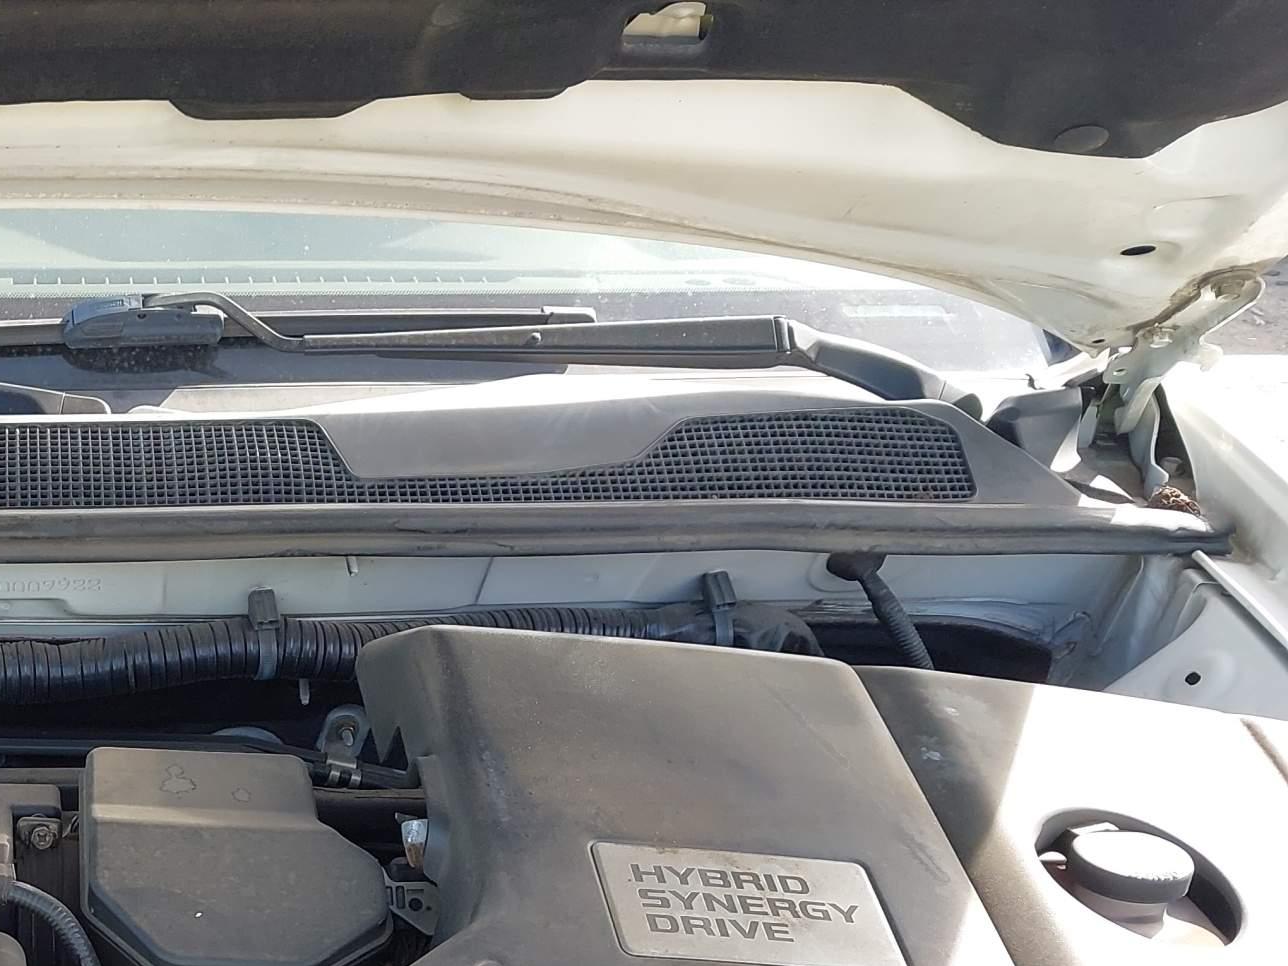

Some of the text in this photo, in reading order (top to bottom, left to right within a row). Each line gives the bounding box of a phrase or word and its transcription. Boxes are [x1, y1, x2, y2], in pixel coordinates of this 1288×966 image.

[630, 863, 810, 895] HYBRID
[637, 888, 859, 924] SYNERGY
[645, 913, 795, 943] DRIVE
